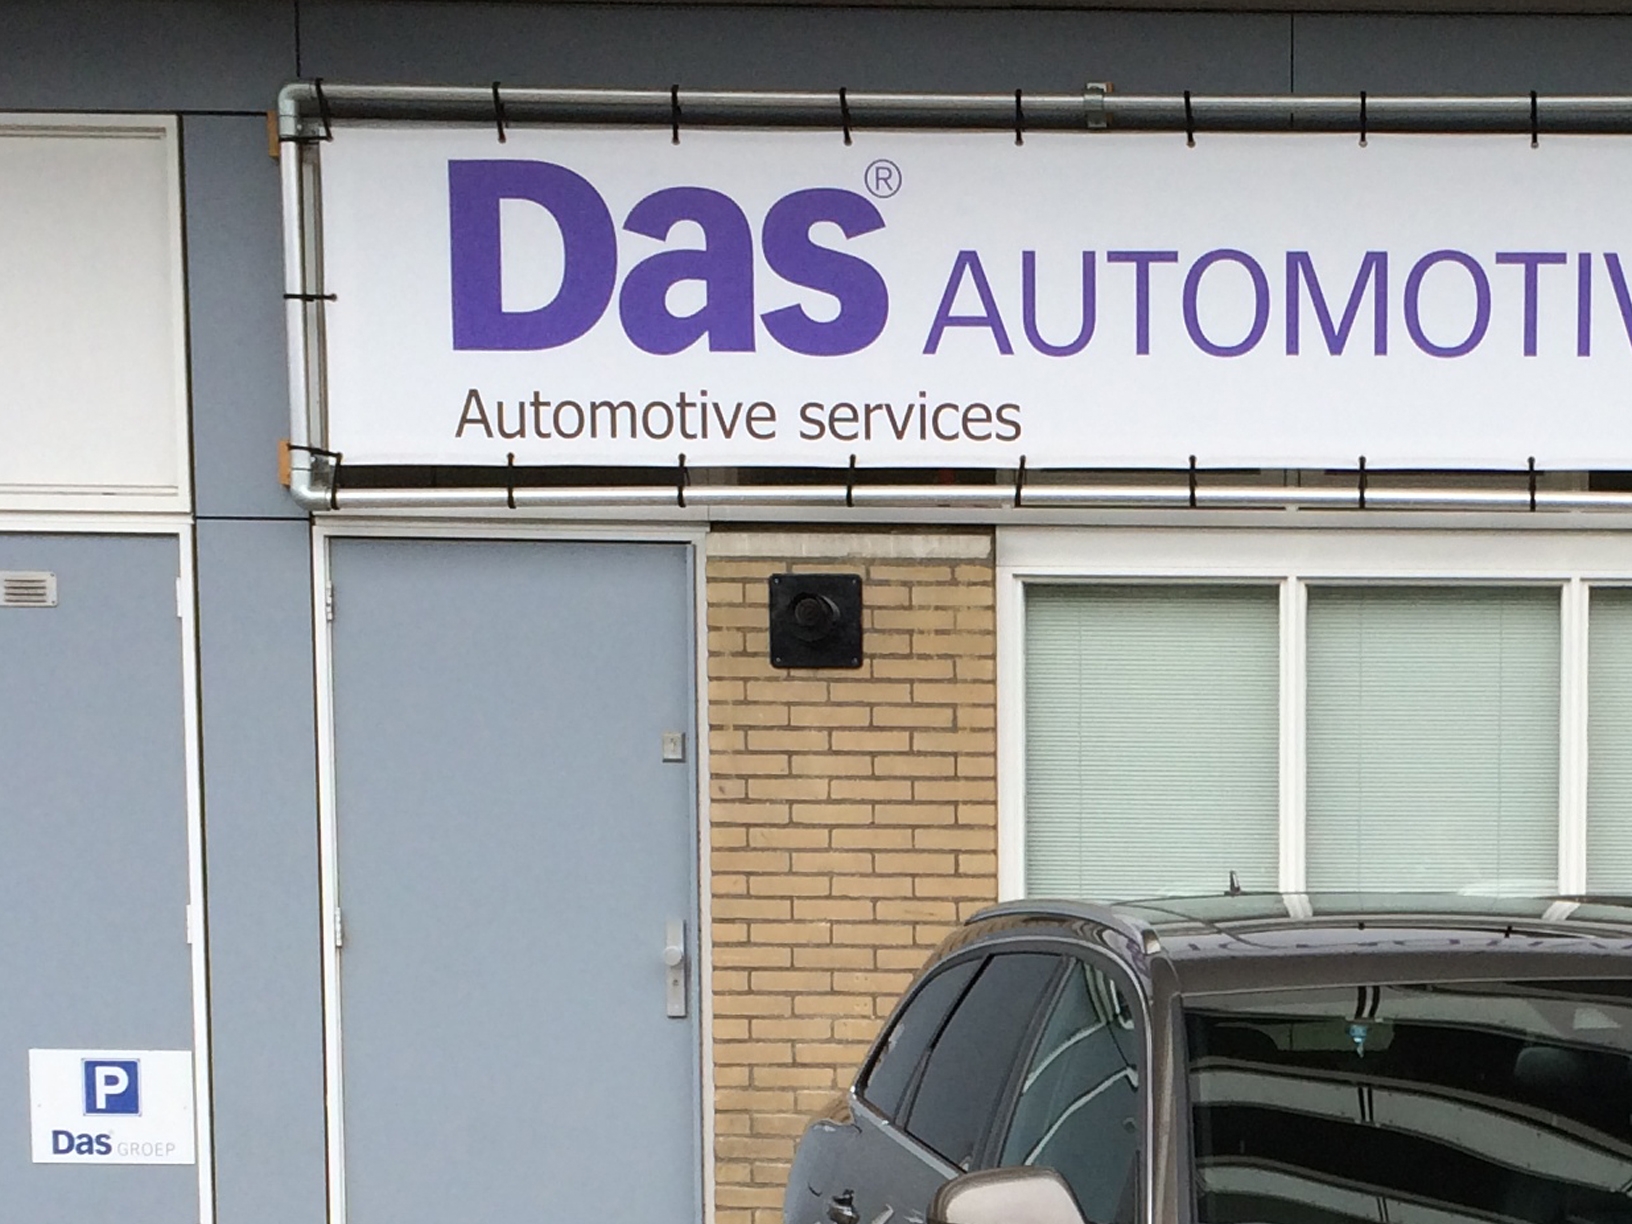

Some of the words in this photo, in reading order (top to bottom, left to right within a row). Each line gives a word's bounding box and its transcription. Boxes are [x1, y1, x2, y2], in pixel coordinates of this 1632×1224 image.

[455, 388, 777, 440] Automotive
[799, 390, 1022, 442] services
[95, 1066, 129, 1109] P
[52, 1129, 112, 1156] Das
[117, 1142, 176, 1157] GROEP
